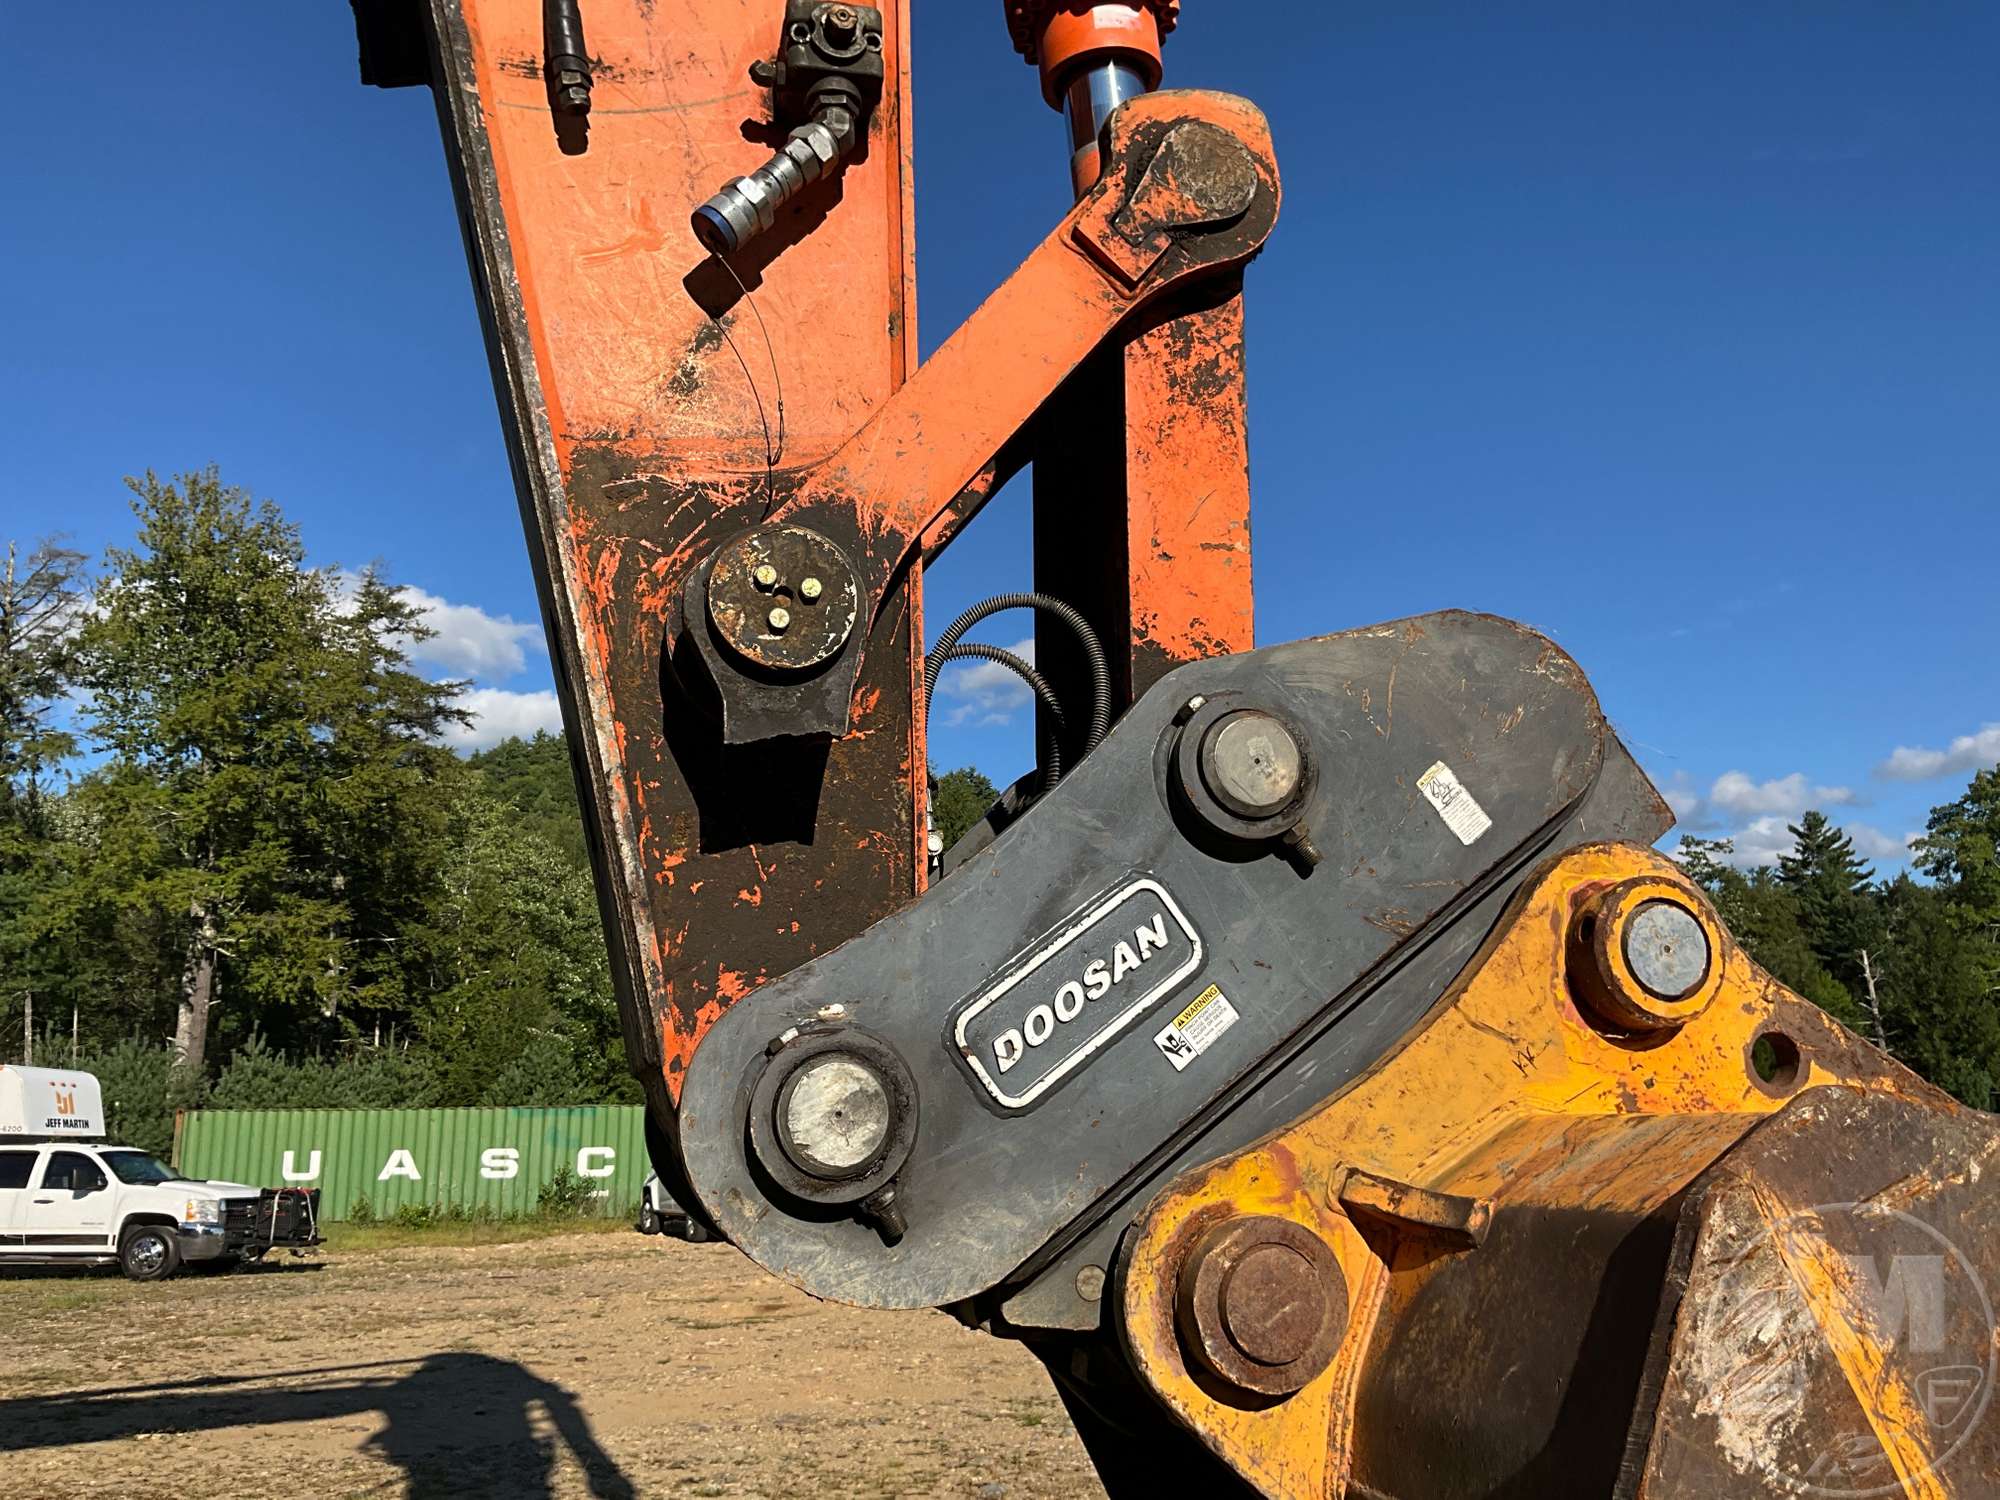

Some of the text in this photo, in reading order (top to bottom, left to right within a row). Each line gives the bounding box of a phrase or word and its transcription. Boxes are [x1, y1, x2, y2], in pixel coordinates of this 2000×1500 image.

[992, 912, 1169, 1074] DOOSAN
[1182, 986, 1218, 1020] WARNING
[45, 1118, 90, 1129] JEFF MARTIN
